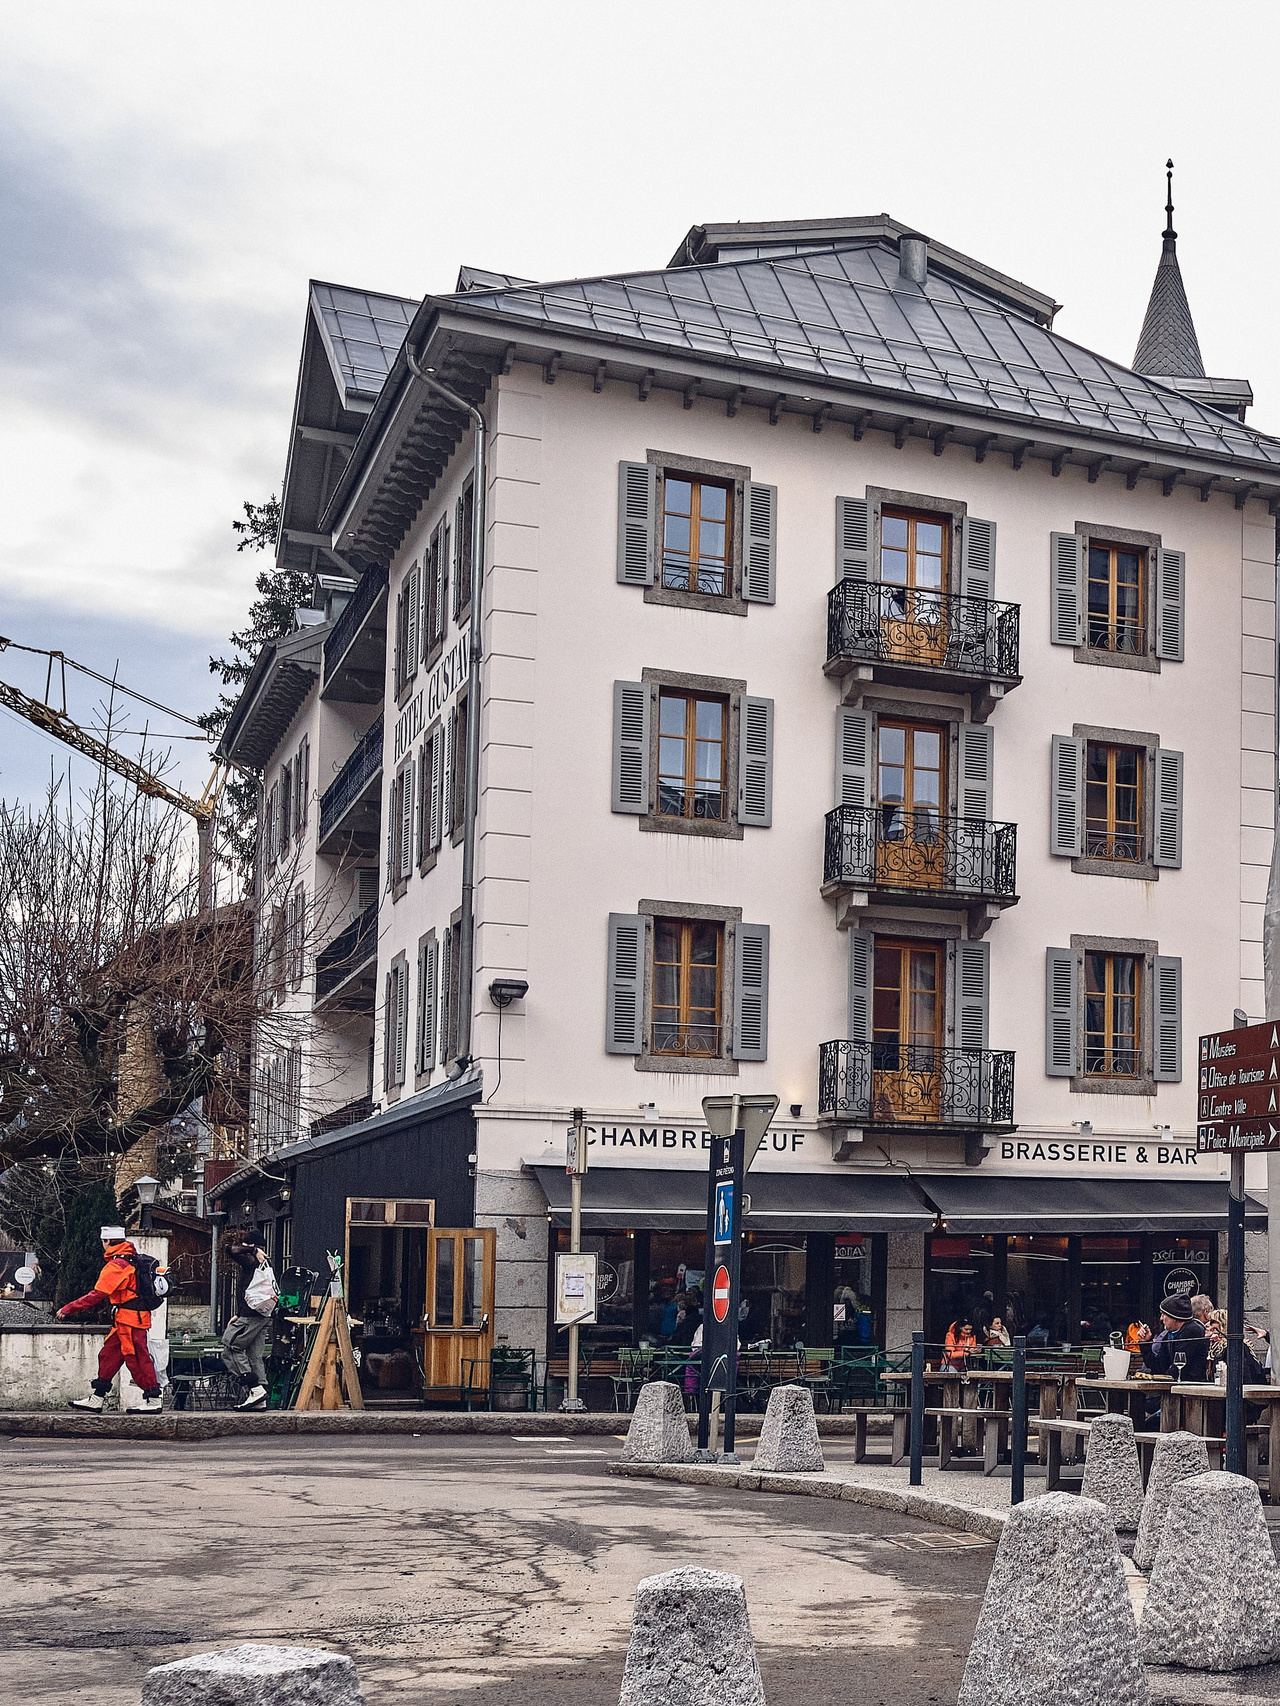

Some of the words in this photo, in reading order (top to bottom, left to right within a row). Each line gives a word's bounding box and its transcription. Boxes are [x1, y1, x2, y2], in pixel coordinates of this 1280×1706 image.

[394, 688, 425, 764] HOTEL
[428, 627, 470, 720] GUSTAV
[1208, 1036, 1237, 1060] Musées
[1208, 1066, 1228, 1088] Office
[1228, 1070, 1237, 1085] de
[1238, 1067, 1265, 1084] Tourisme
[1210, 1095, 1233, 1117] Centre
[1234, 1098, 1247, 1115] Ville
[1206, 1127, 1227, 1150] Police
[1228, 1124, 1266, 1150] Municipale
[1001, 1142, 1127, 1163] BRASSERIE
[1135, 1146, 1149, 1164] &
[1157, 1147, 1198, 1165] BAR
